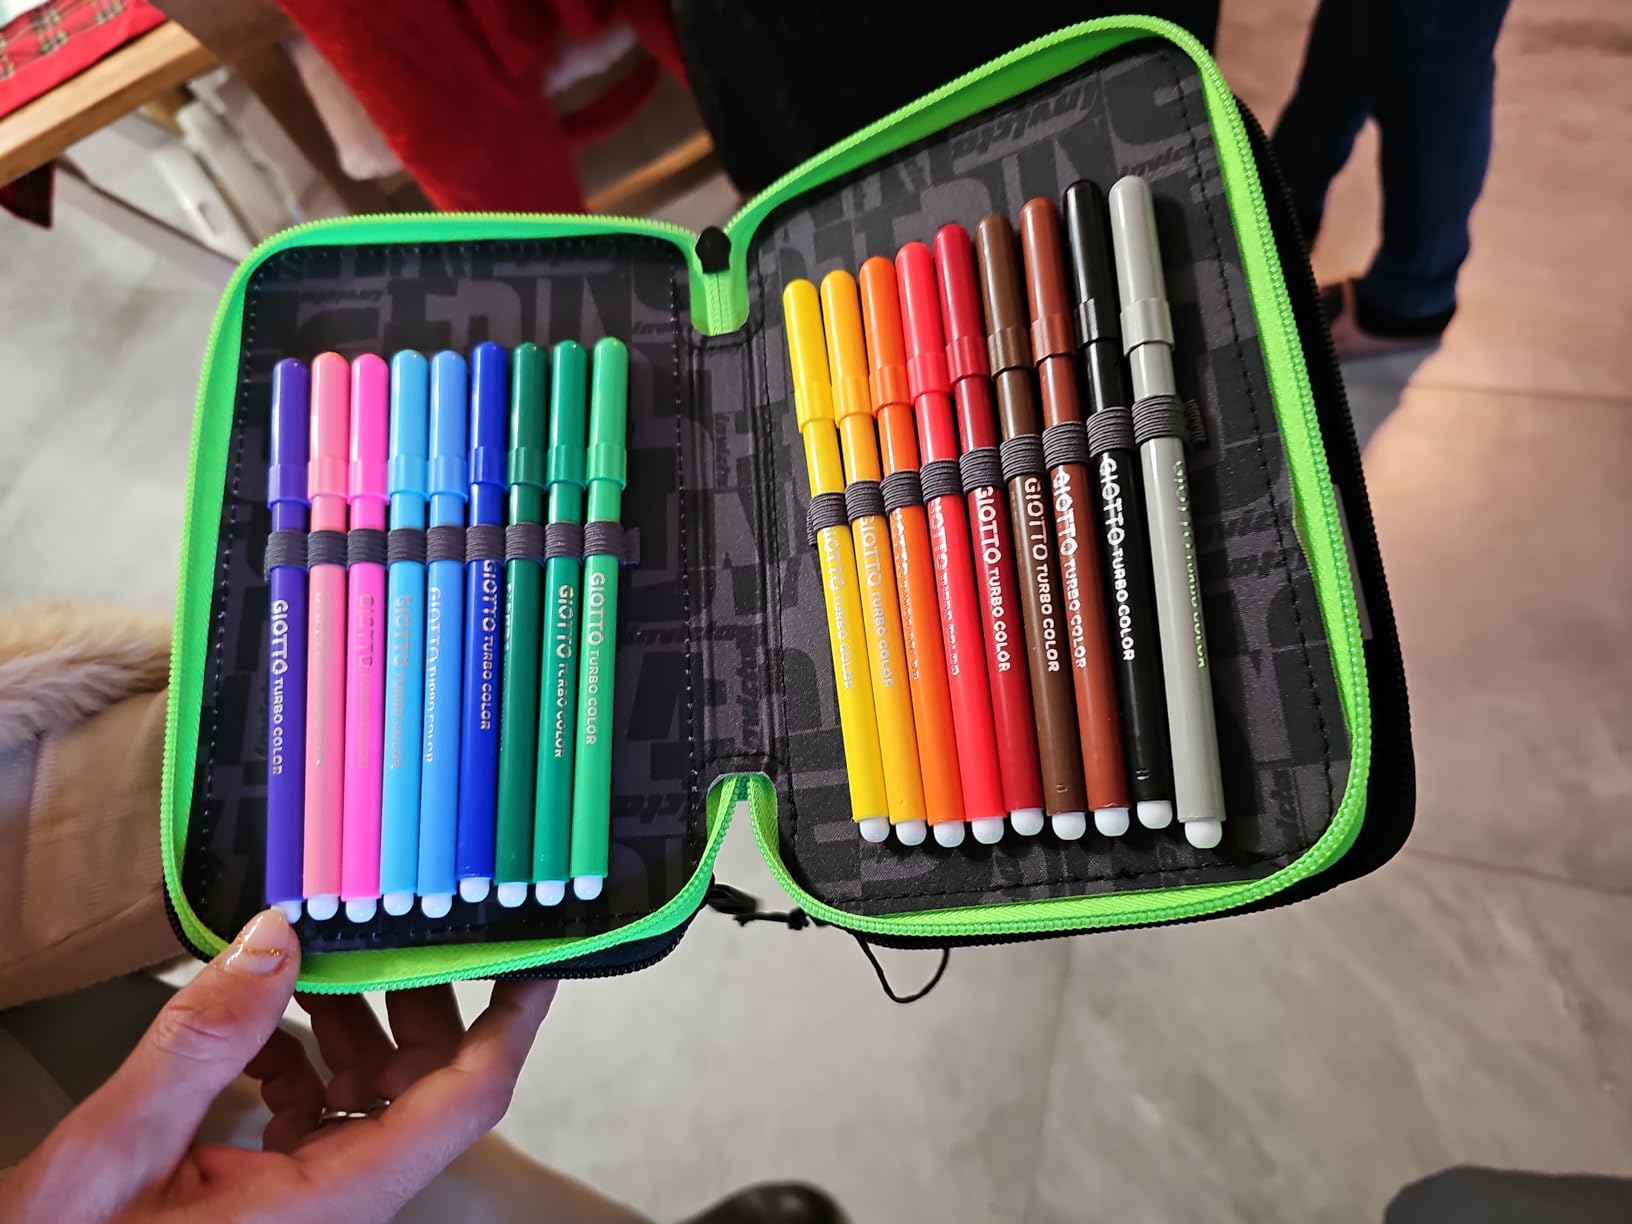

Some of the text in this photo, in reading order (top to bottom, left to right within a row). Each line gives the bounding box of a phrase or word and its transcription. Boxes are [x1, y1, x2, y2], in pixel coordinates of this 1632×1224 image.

[481, 560, 497, 730] GIOTTO TURBO COLOR
[556, 585, 574, 658] GIOTTO
[872, 591, 886, 635] TURBO
[976, 487, 1011, 672] GIOTTO TURBO COLOR
[1024, 478, 1060, 672] GIOTTO TURBO COLOR
[1053, 472, 1087, 668] GIOTTO TURBO COLOR
[1099, 457, 1135, 661] GIOTTO TURBO COLOR
[271, 600, 288, 775] GIOTTO TURBO COLOR
[586, 572, 605, 744] GIOTTO TURBO COLOR
